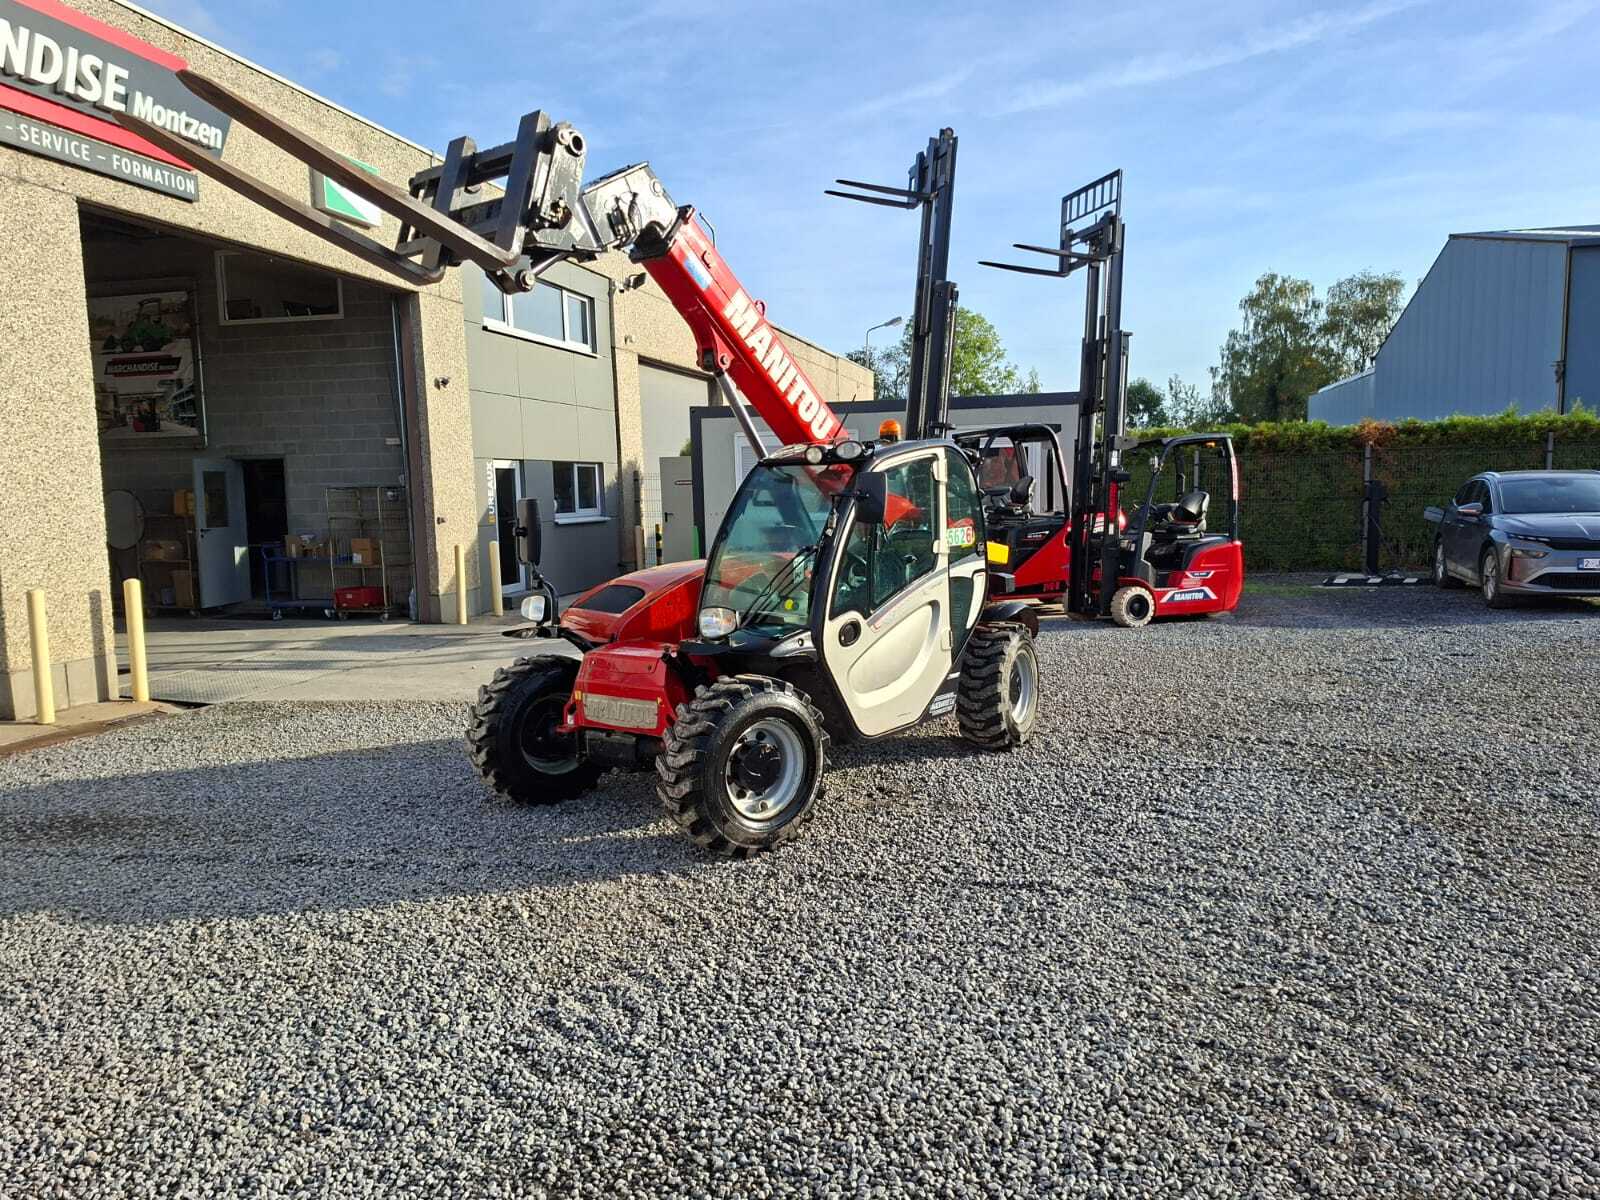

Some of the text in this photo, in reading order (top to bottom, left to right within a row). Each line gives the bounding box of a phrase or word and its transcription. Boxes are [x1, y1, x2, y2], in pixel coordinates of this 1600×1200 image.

[133, 90, 223, 150] Montzen
[19, 123, 91, 162] SERVICE
[112, 153, 196, 195] FORMATION
[722, 287, 834, 440] MANITOU
